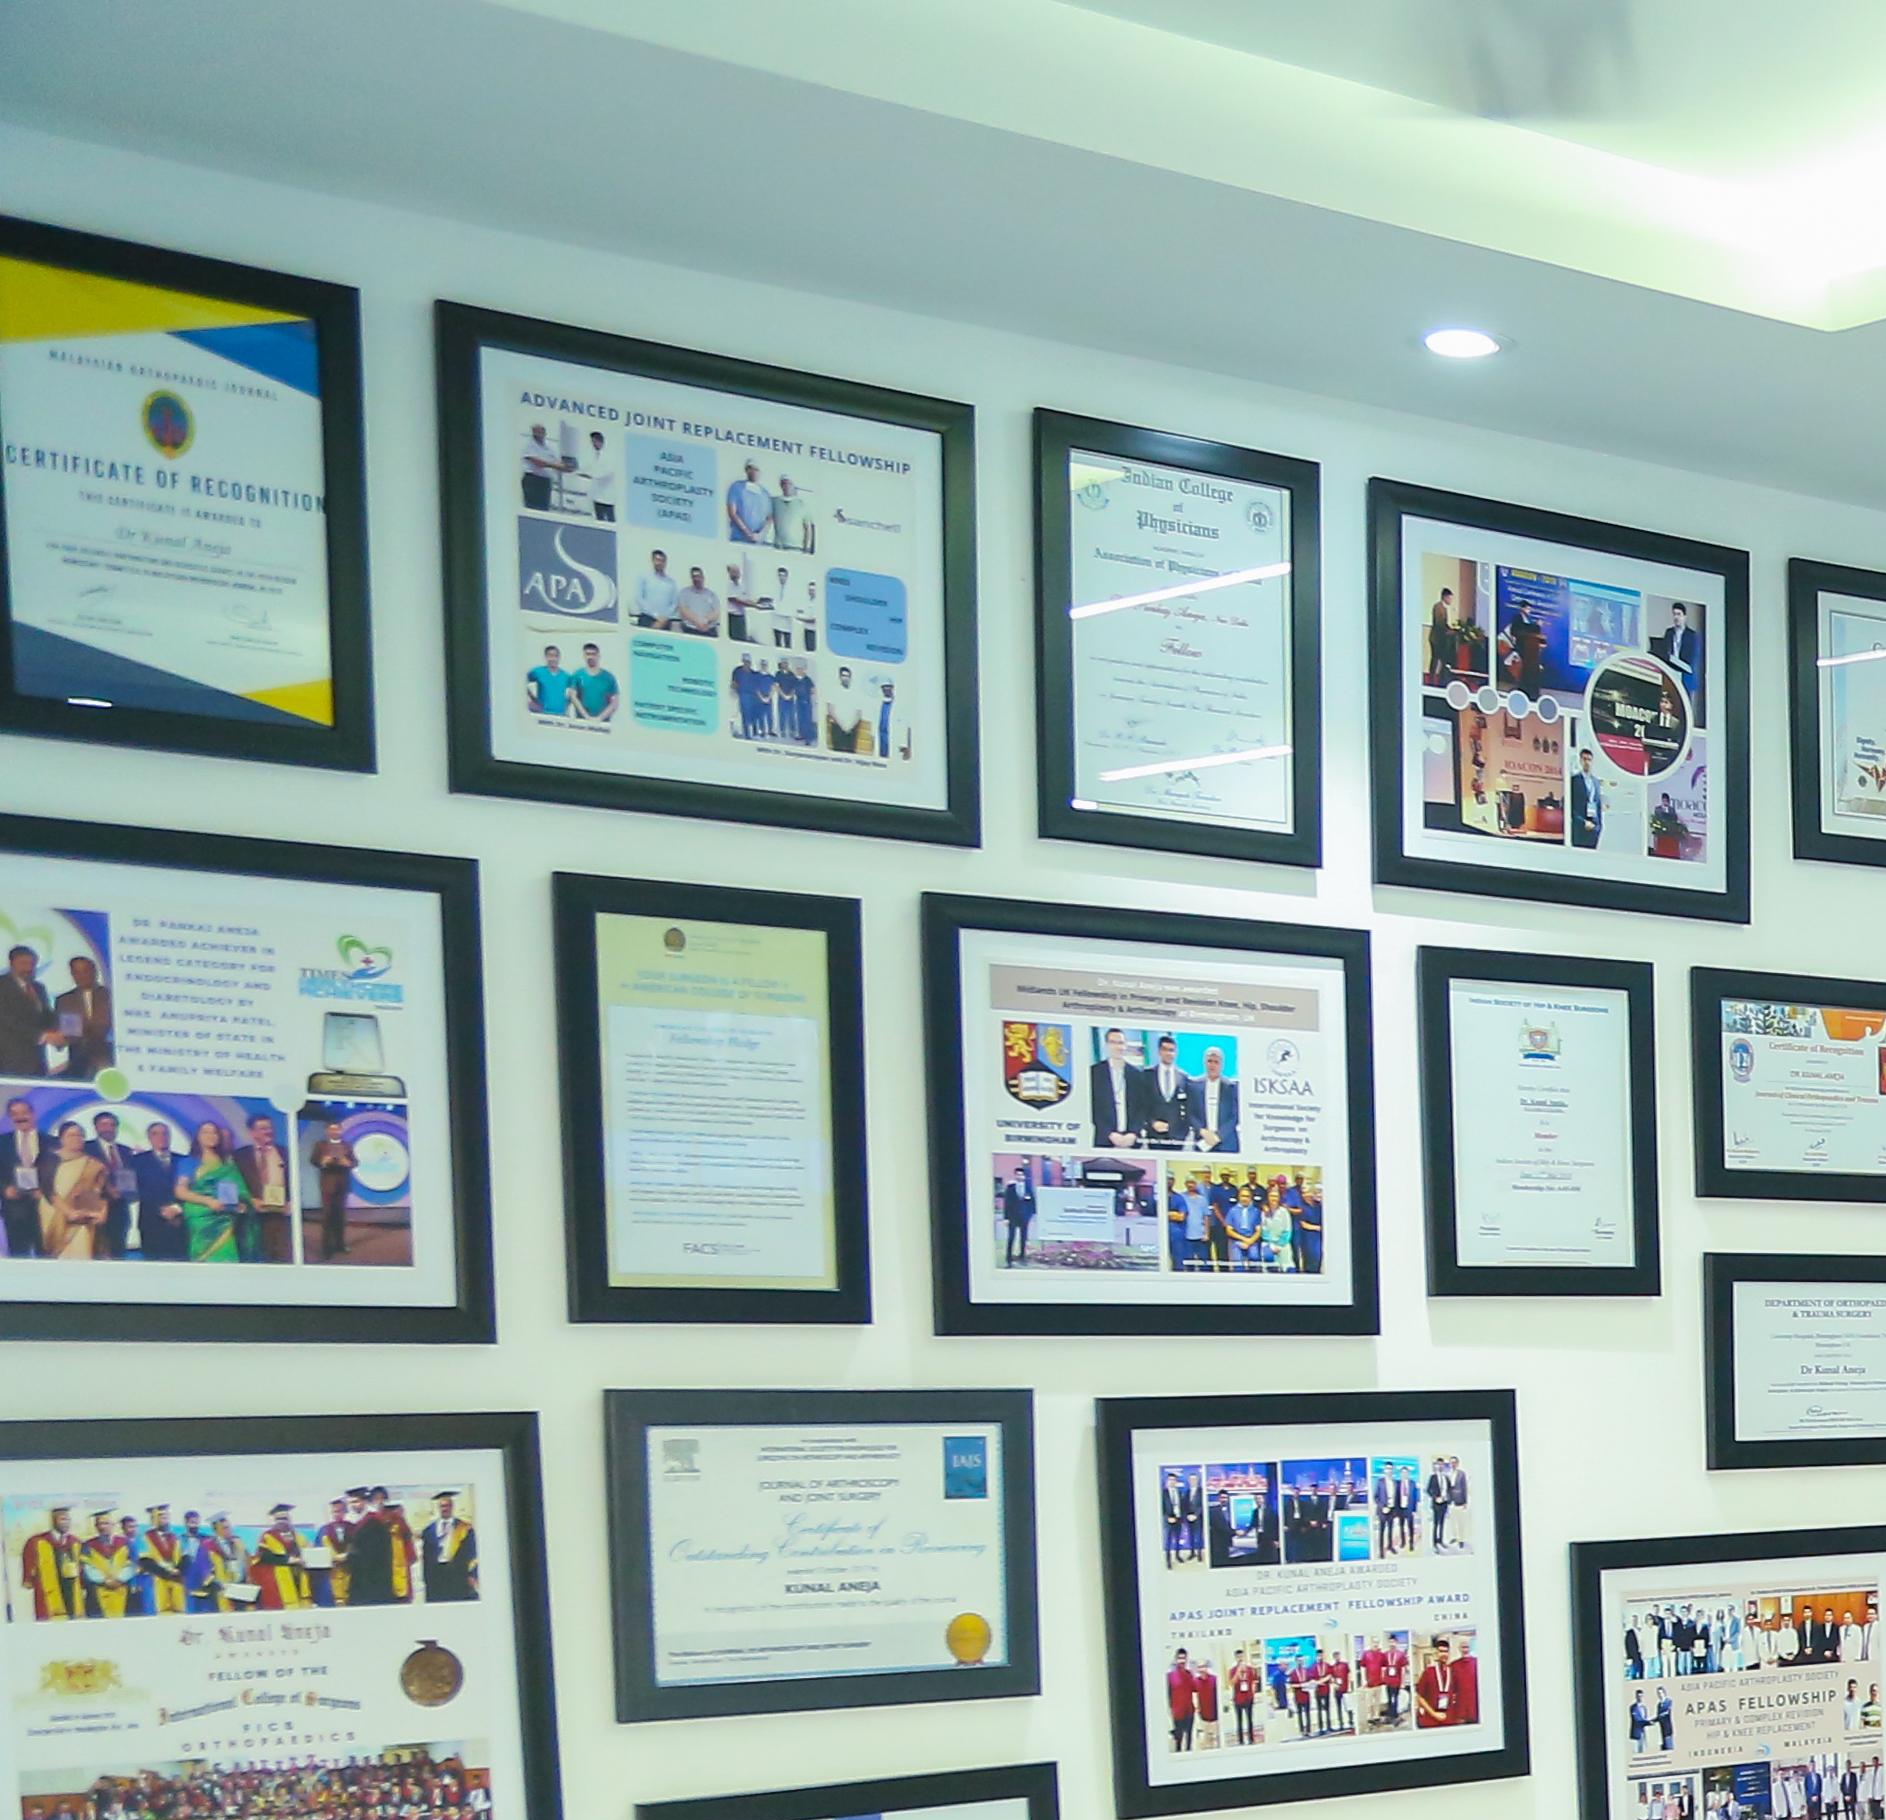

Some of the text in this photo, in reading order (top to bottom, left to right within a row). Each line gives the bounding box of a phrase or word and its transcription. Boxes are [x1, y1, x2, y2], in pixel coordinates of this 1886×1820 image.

[521, 391, 911, 474] ADVANCED JOINT REPLACEMENT FELLOWSHIP
[156, 469, 179, 489] OF
[1254, 1077, 1314, 1097] ISKSAA
[1685, 1690, 1837, 1716] APAS FELLOWSHIP
